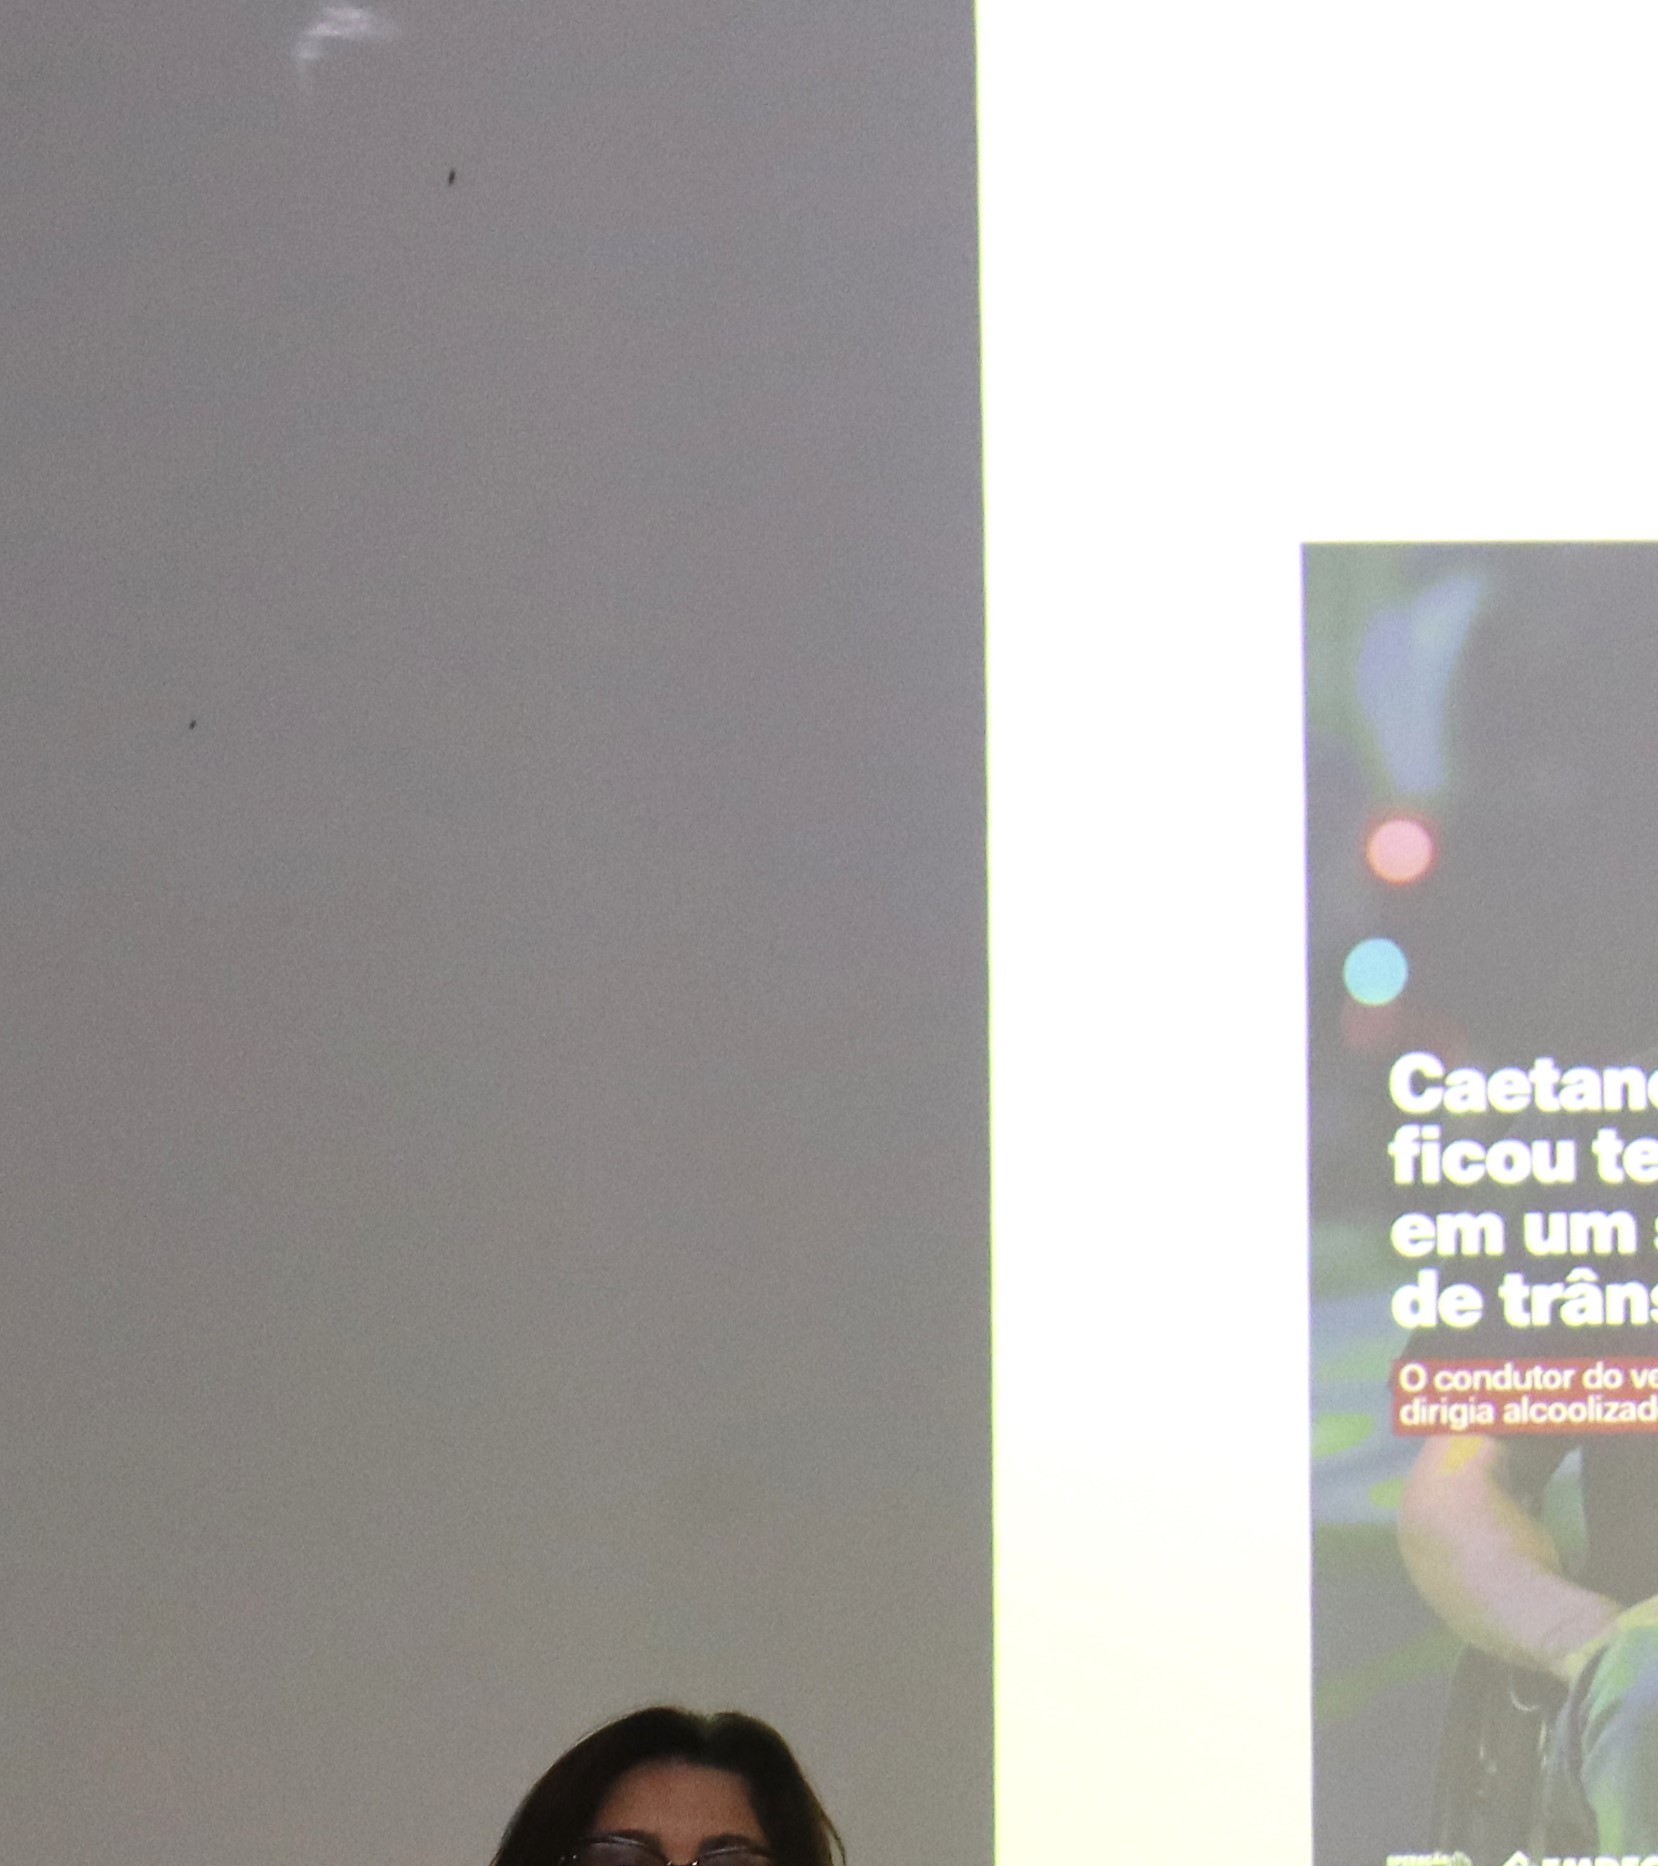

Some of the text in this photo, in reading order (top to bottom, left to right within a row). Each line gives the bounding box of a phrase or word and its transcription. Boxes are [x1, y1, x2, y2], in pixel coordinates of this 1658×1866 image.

[1387, 1125, 1578, 1186] ficou
[1390, 1208, 1505, 1256] em
[1523, 1207, 1638, 1255] um
[1390, 1269, 1485, 1328] de
[1400, 1364, 1427, 1392] O
[1434, 1361, 1573, 1392] condutor
[1583, 1360, 1622, 1390] do
[1399, 1397, 1496, 1431] dirigia
